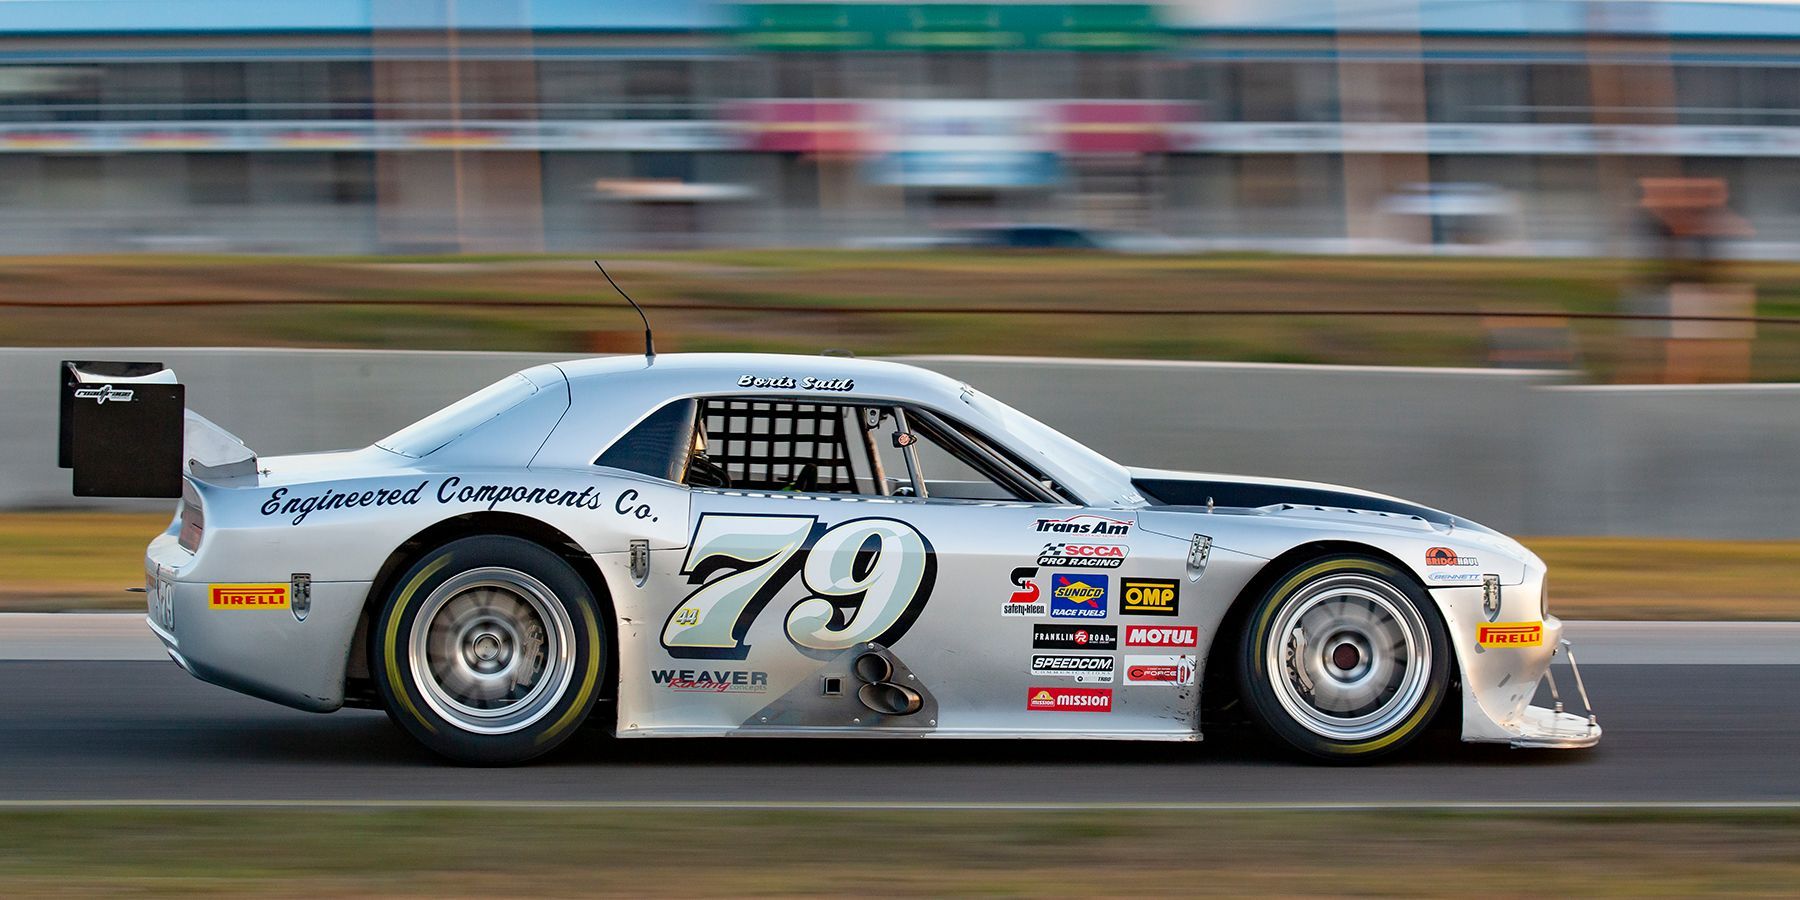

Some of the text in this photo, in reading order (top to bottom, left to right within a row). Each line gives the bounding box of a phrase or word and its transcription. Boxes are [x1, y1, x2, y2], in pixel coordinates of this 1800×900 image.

[737, 374, 855, 391] Boris Said
[261, 476, 659, 525] Engineered Components Co.
[1036, 519, 1129, 535] Trans Am
[1065, 545, 1123, 557] SCCA
[1039, 557, 1121, 567] PRO RACING
[660, 512, 938, 661] 79
[1055, 587, 1104, 597] SUNOCO
[213, 588, 285, 604] PIRELLI
[1125, 588, 1174, 606] OMP
[677, 608, 700, 625] 44
[1003, 604, 1045, 615] safety-kleen
[1052, 609, 1106, 617] RACE FUELS
[1034, 633, 1074, 641] FRANKLIN
[1129, 629, 1195, 643] MOTUL
[1480, 626, 1541, 643] PIRELLI
[651, 670, 768, 685] WEAVER
[668, 678, 731, 693] Racing
